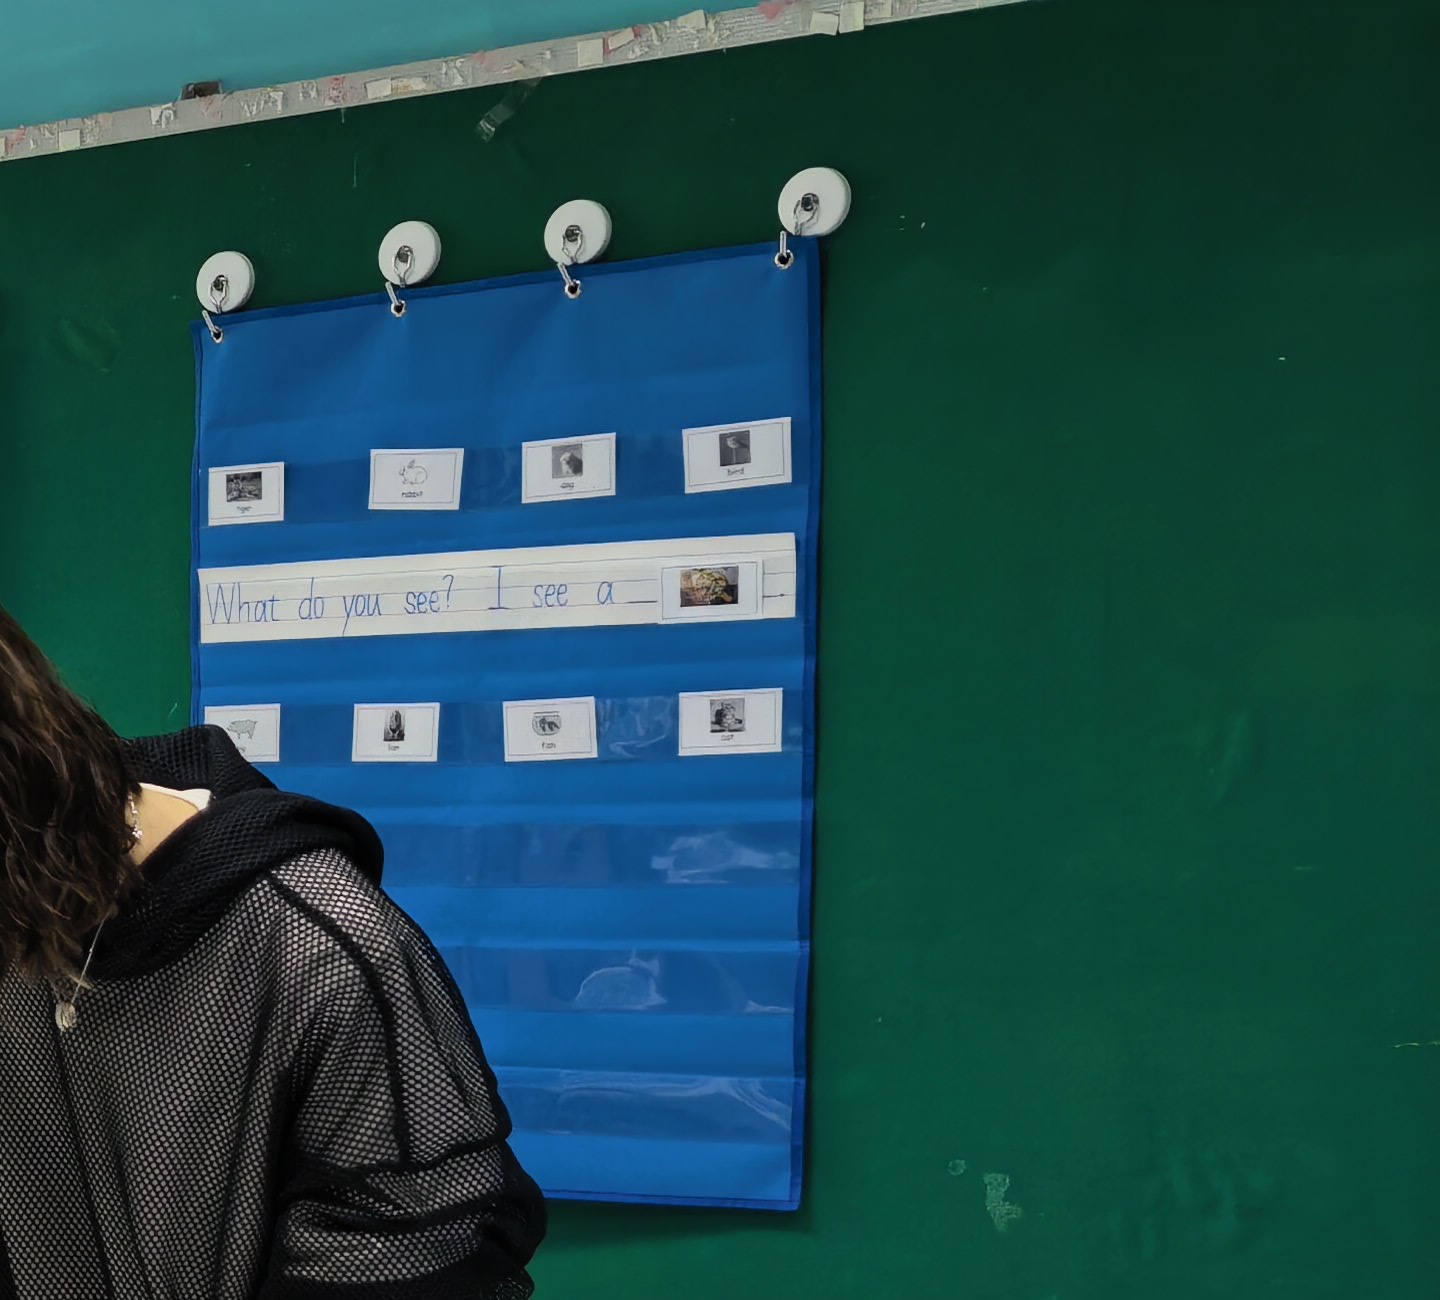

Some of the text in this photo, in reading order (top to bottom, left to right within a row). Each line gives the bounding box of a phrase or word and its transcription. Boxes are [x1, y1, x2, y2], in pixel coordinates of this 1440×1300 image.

[205, 566, 614, 635] What do you see? I see a
